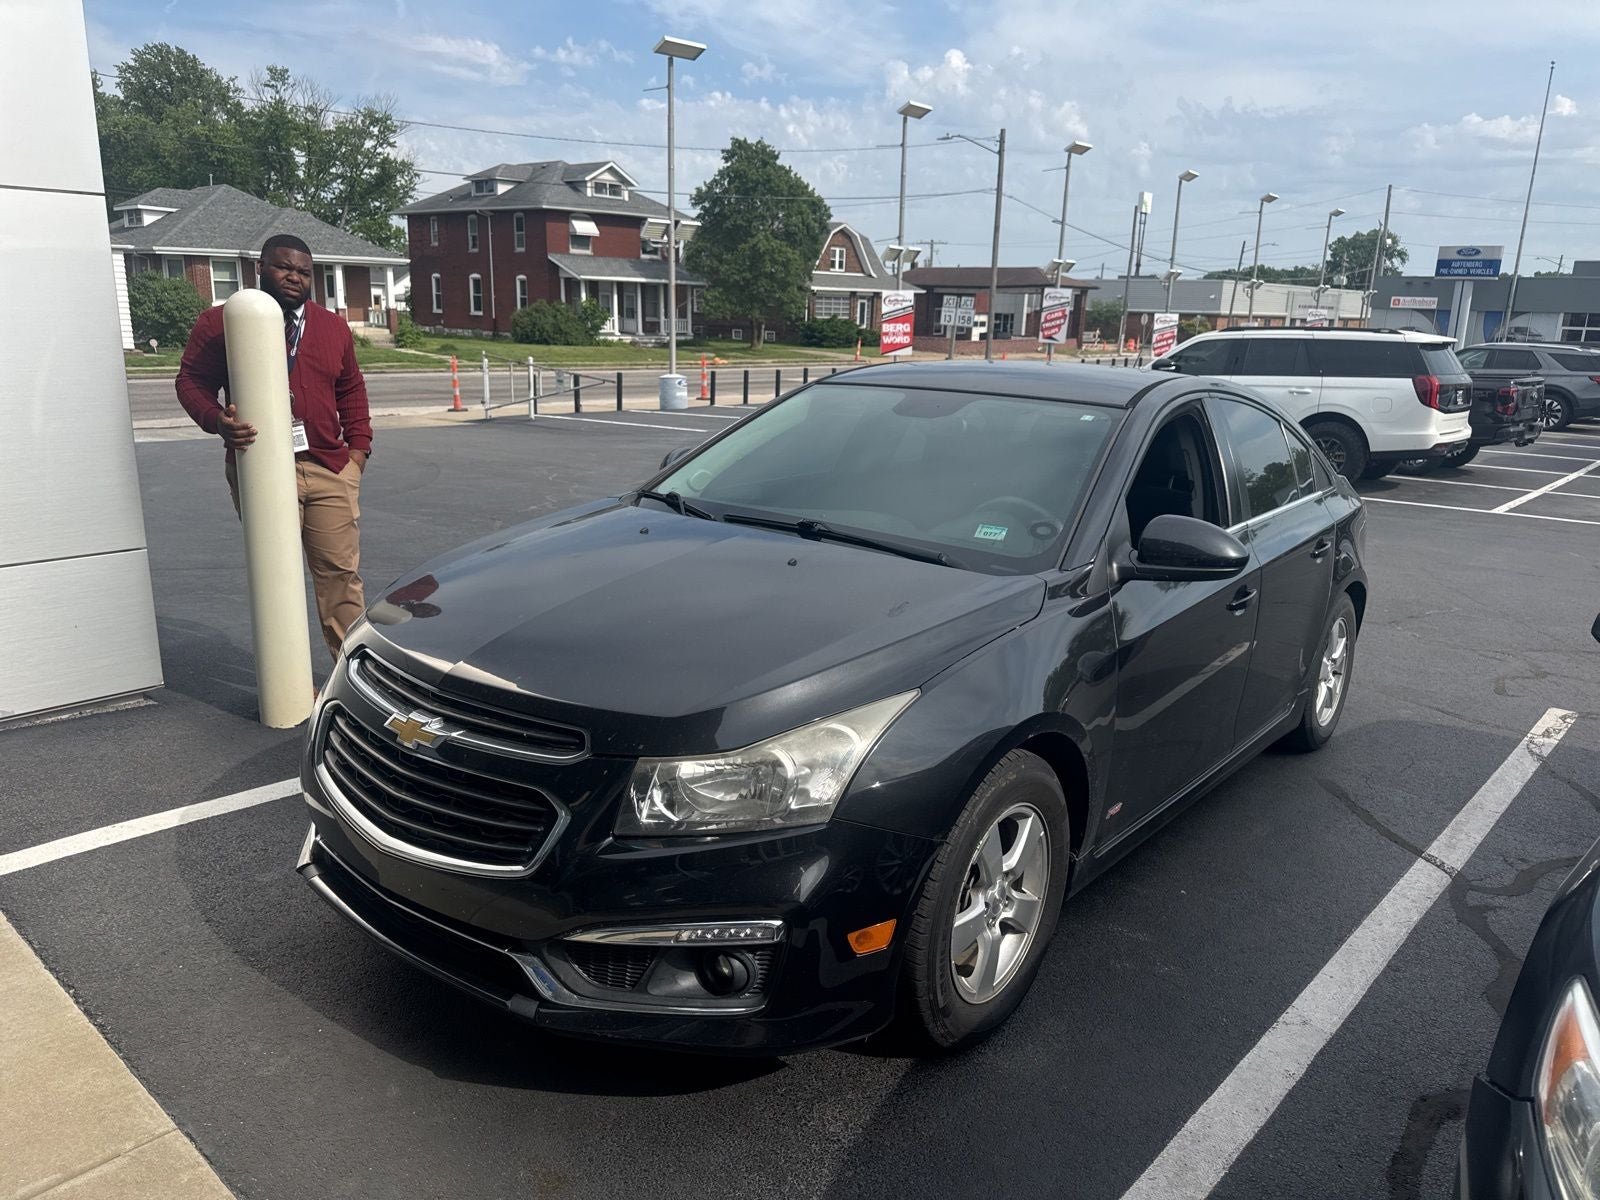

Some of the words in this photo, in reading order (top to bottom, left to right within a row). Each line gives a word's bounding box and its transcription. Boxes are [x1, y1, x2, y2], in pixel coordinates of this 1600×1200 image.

[944, 297, 955, 306] JCT
[962, 299, 973, 307] JCT
[943, 314, 952, 323] 13
[957, 315, 972, 325] 158
[882, 323, 911, 332] BERG
[882, 335, 911, 344] WORD
